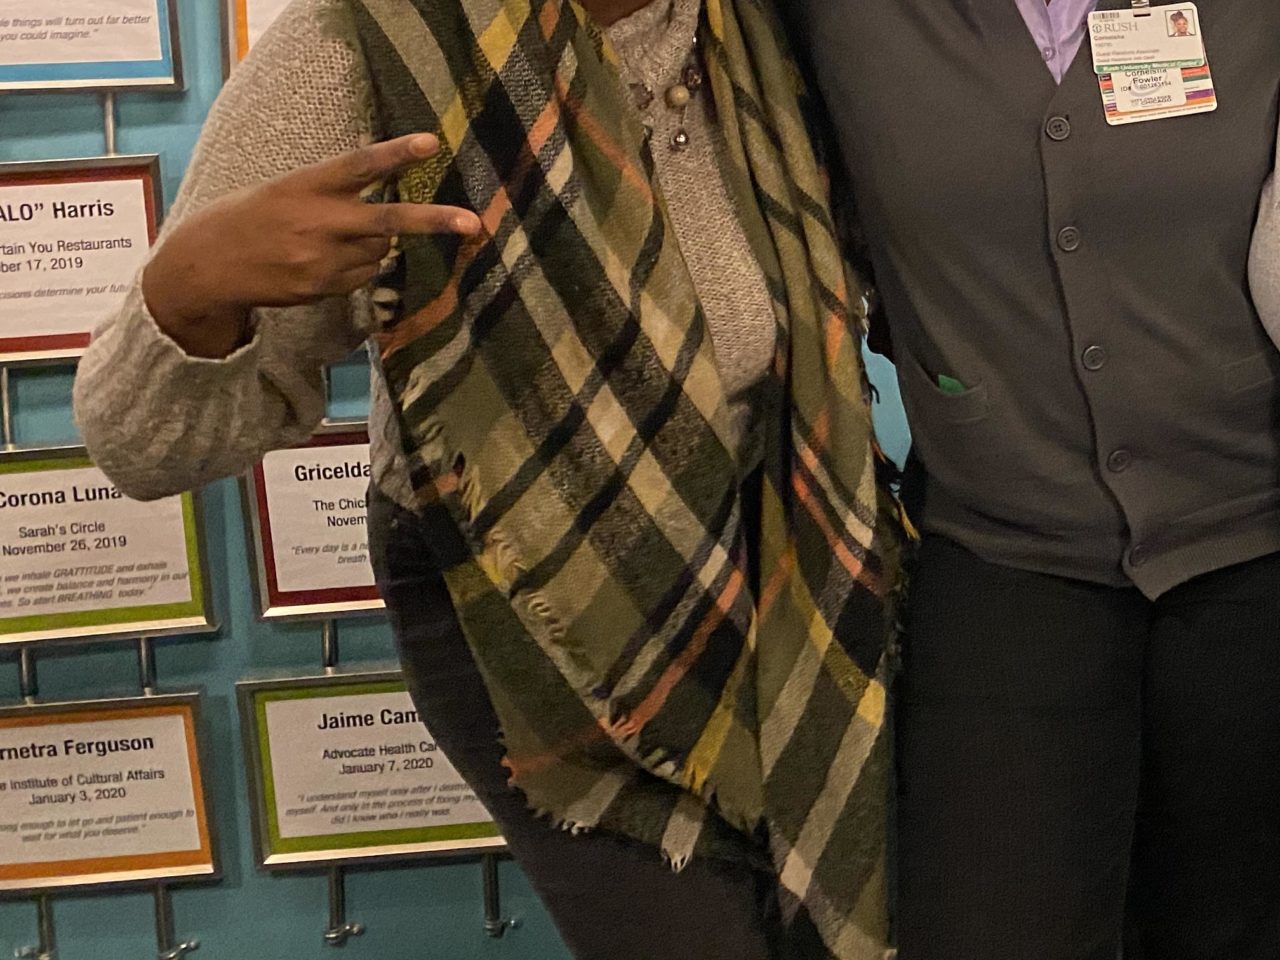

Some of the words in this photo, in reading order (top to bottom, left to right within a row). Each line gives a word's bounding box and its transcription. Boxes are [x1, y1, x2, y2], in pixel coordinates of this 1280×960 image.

[1104, 21, 1138, 32] RUSH
[1132, 75, 1162, 84] Fowler
[52, 199, 114, 219] Harris
[29, 242, 53, 254] You
[57, 238, 132, 252] Restaurants
[26, 259, 46, 271] 17,
[50, 256, 83, 270] 2019
[294, 461, 371, 481] Gricelda
[72, 486, 123, 502] Luna
[312, 500, 335, 511] The
[18, 524, 67, 539] Sarah's
[70, 521, 105, 535] Circle
[2, 542, 66, 556] November
[70, 539, 90, 551] 26,
[94, 535, 127, 549] 2019
[317, 712, 375, 730] Jaime
[64, 737, 154, 757] Ferguson
[322, 747, 376, 759] Advocate
[379, 743, 416, 756] Health
[10, 777, 58, 790] Institute
[61, 774, 73, 787] of
[77, 771, 123, 786] Cultural
[126, 768, 165, 781] Affairs
[28, 793, 76, 805] January
[79, 790, 92, 802] 3,
[94, 787, 126, 800] 2020
